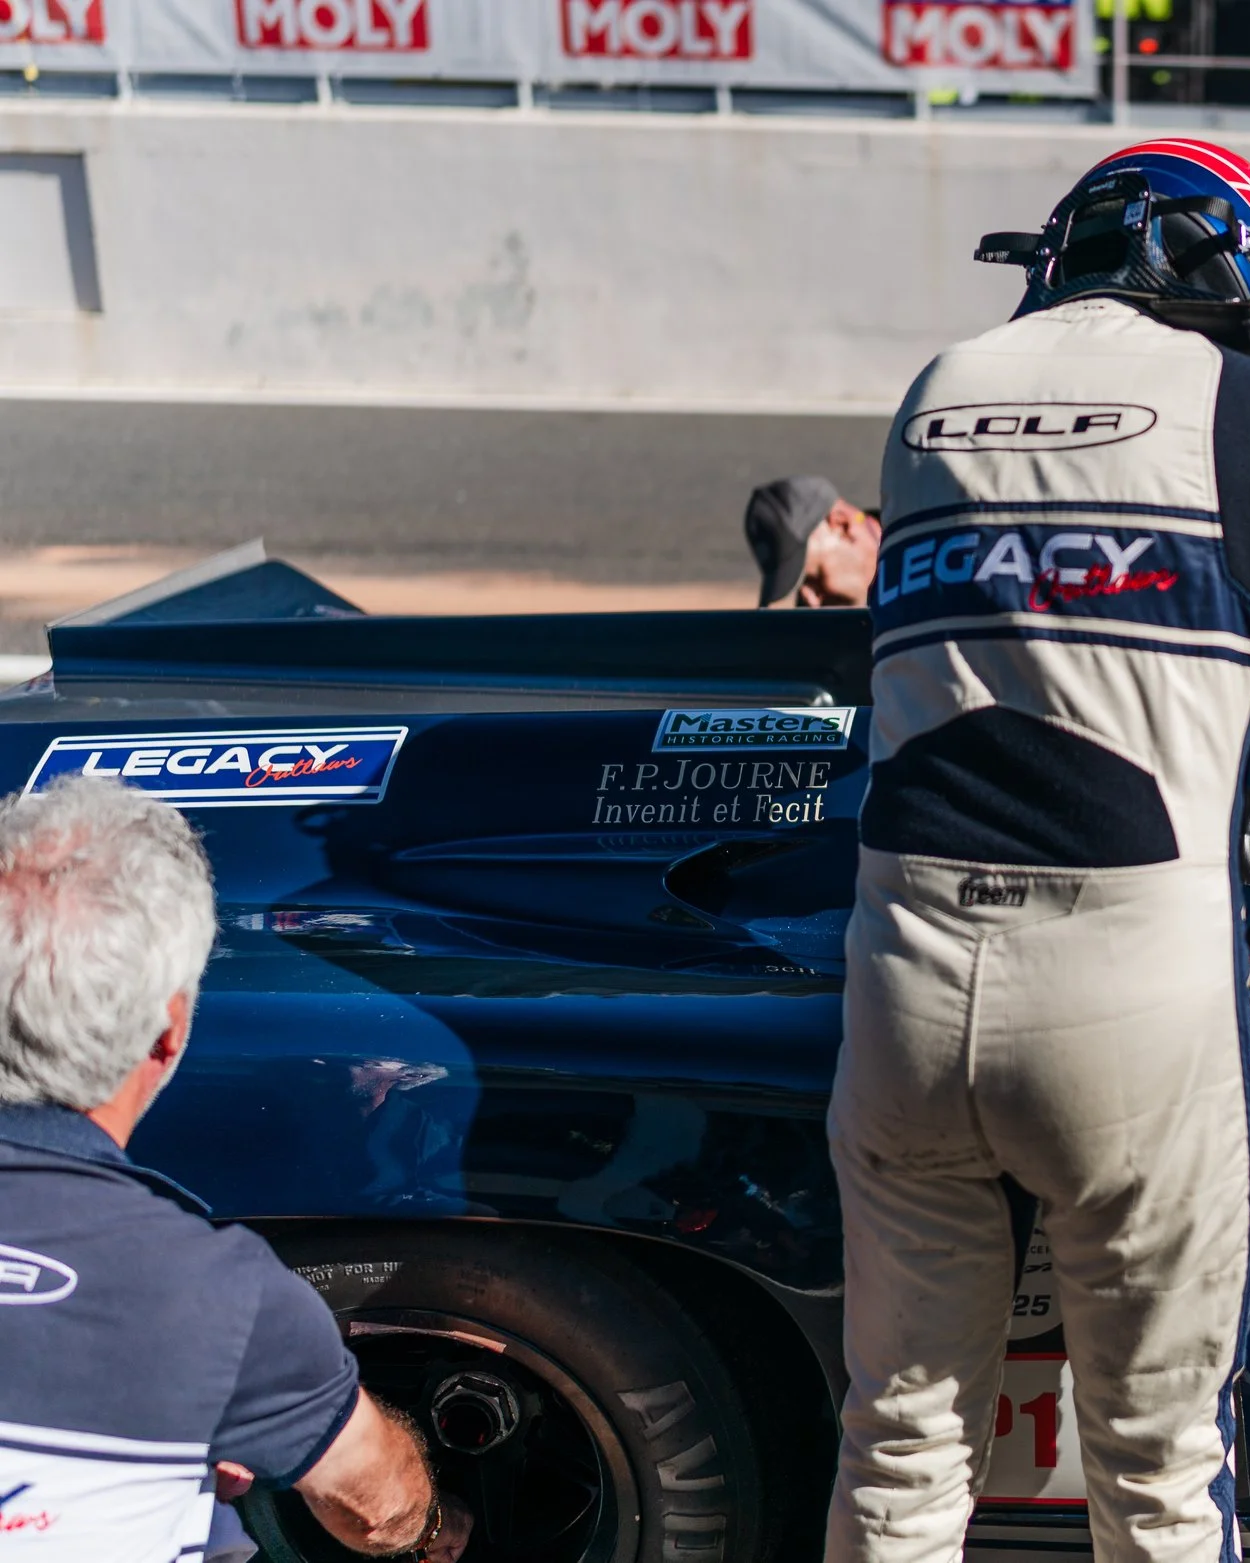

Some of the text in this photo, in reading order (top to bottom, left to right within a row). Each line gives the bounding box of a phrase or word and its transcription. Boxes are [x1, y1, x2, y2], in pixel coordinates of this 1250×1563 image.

[245, 0, 424, 48] MOLY
[568, 0, 749, 55] MOLY
[890, 6, 1069, 64] MOLY
[926, 412, 1122, 439] LOLA
[877, 531, 1156, 607] LEGACY
[670, 712, 841, 733] Masters
[666, 733, 837, 745] HISTORIC RACING
[81, 743, 350, 777] LEGACY
[244, 755, 363, 788] Outlaws
[591, 793, 826, 824] Invenit et Fecit
[344, 1263, 373, 1276] FOR
[1012, 1294, 1051, 1316] 25
